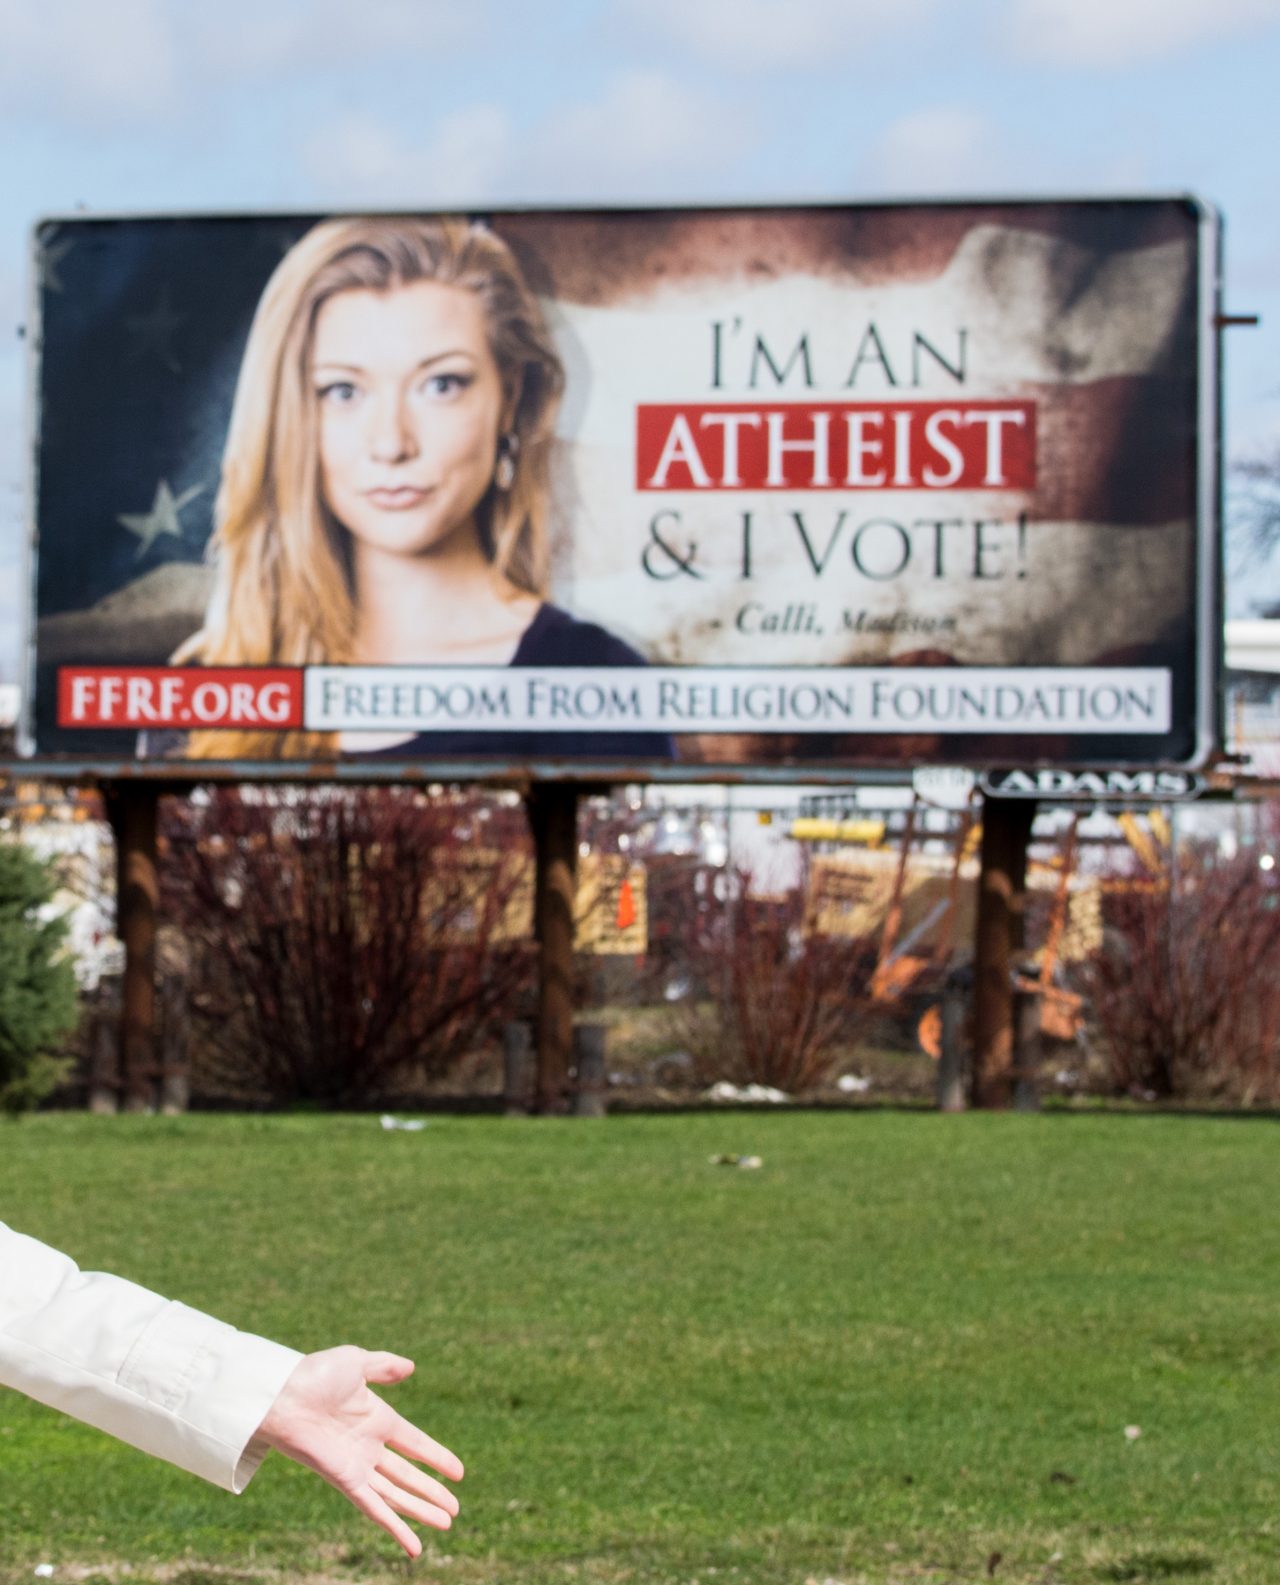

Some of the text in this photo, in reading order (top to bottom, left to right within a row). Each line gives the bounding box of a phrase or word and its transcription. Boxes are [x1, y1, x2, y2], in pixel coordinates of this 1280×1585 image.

[846, 320, 969, 389] AN
[647, 409, 1026, 488] ATHEIST
[641, 508, 1028, 581] & I VOTE!
[735, 602, 824, 637] Calli,
[71, 676, 291, 723] FFRF.ORG
[322, 678, 1157, 722] FREEDOM FROM RELIGION FOUNDATION
[999, 769, 1188, 796] ADAMS
